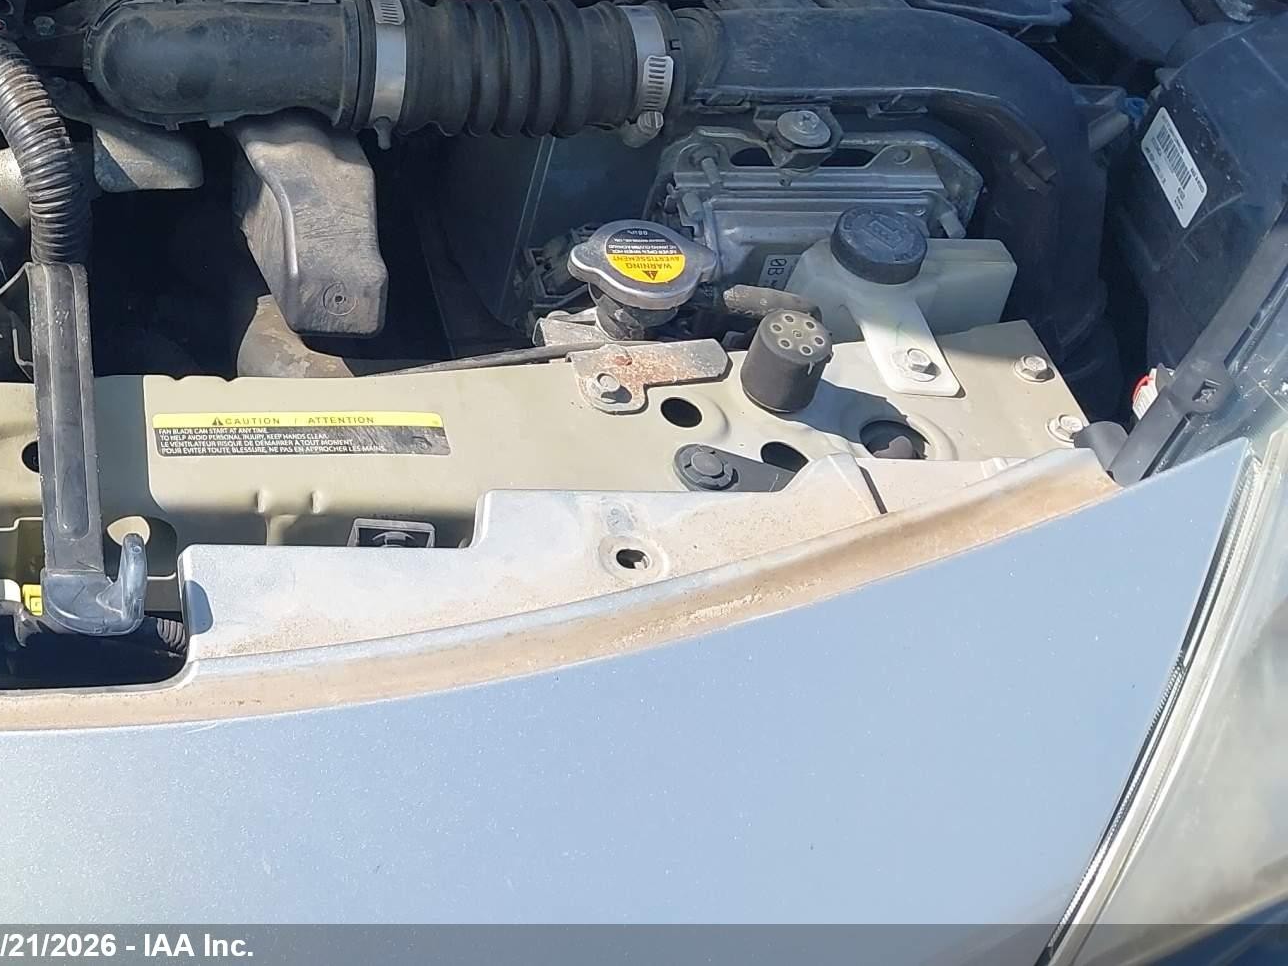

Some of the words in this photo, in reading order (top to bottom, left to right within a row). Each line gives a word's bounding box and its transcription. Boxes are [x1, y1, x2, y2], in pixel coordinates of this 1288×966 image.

[625, 262, 673, 270] WARNING
[224, 417, 281, 425] CAUTION
[307, 416, 375, 424] ATTENTION
